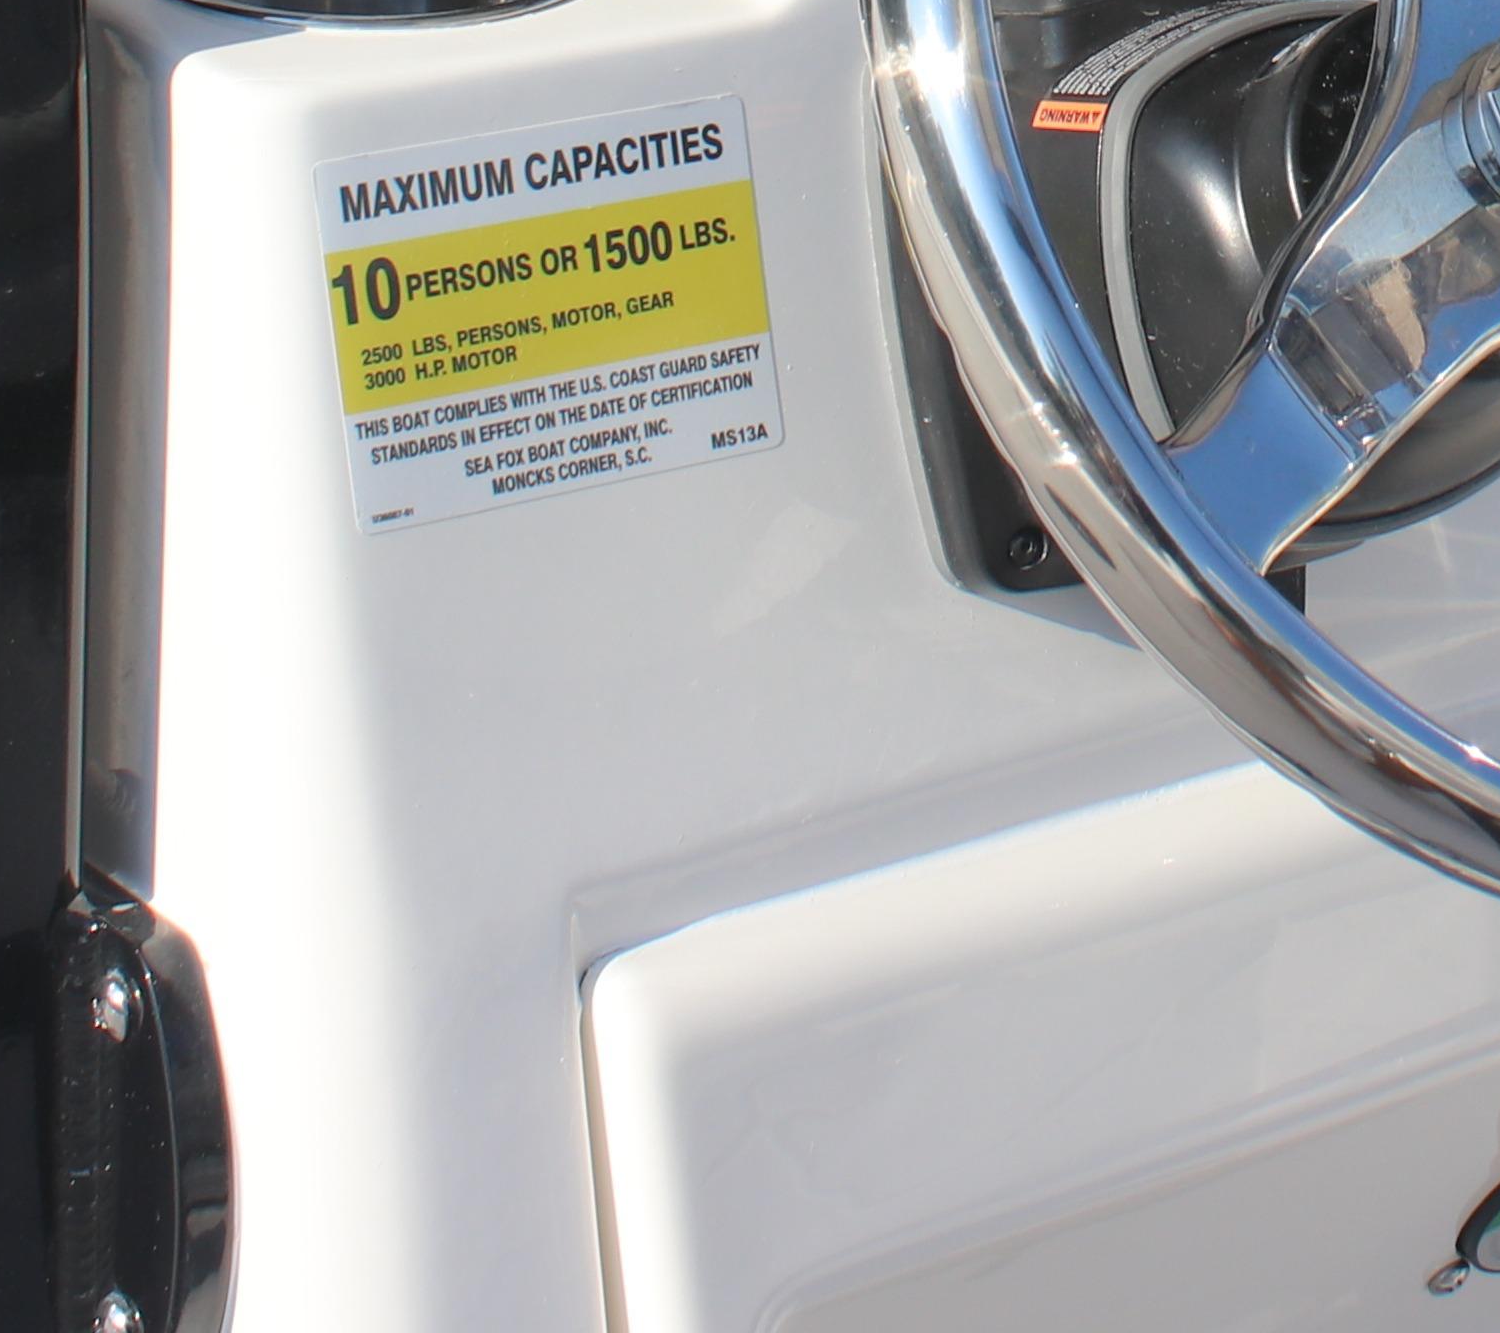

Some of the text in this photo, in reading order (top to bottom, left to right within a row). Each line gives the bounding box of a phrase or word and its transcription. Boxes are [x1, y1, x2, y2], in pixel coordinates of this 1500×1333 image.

[1039, 107, 1091, 125] WARNING
[338, 122, 725, 223] MAXIMUM CAPACITIES
[329, 215, 736, 329] 10 PERSONS OR 1500 LBS.
[360, 291, 675, 367] 2500 LBS, PERSONS, MOTOR, GEAR
[355, 343, 762, 441] THIS BOAT COMPLIES WITH THE U.S. COAST GUARD SAFETY
[363, 344, 518, 391] 3000 H.P. MOTOR
[370, 371, 754, 465] STANDARDS IN EFFECT ON THE DATE OF CERTIFICATION
[463, 417, 673, 477] SEA FOX BOAT COMPANY, INC.
[710, 422, 769, 450] MS13A
[491, 445, 653, 496] MONCKS CORNER, S.C.
